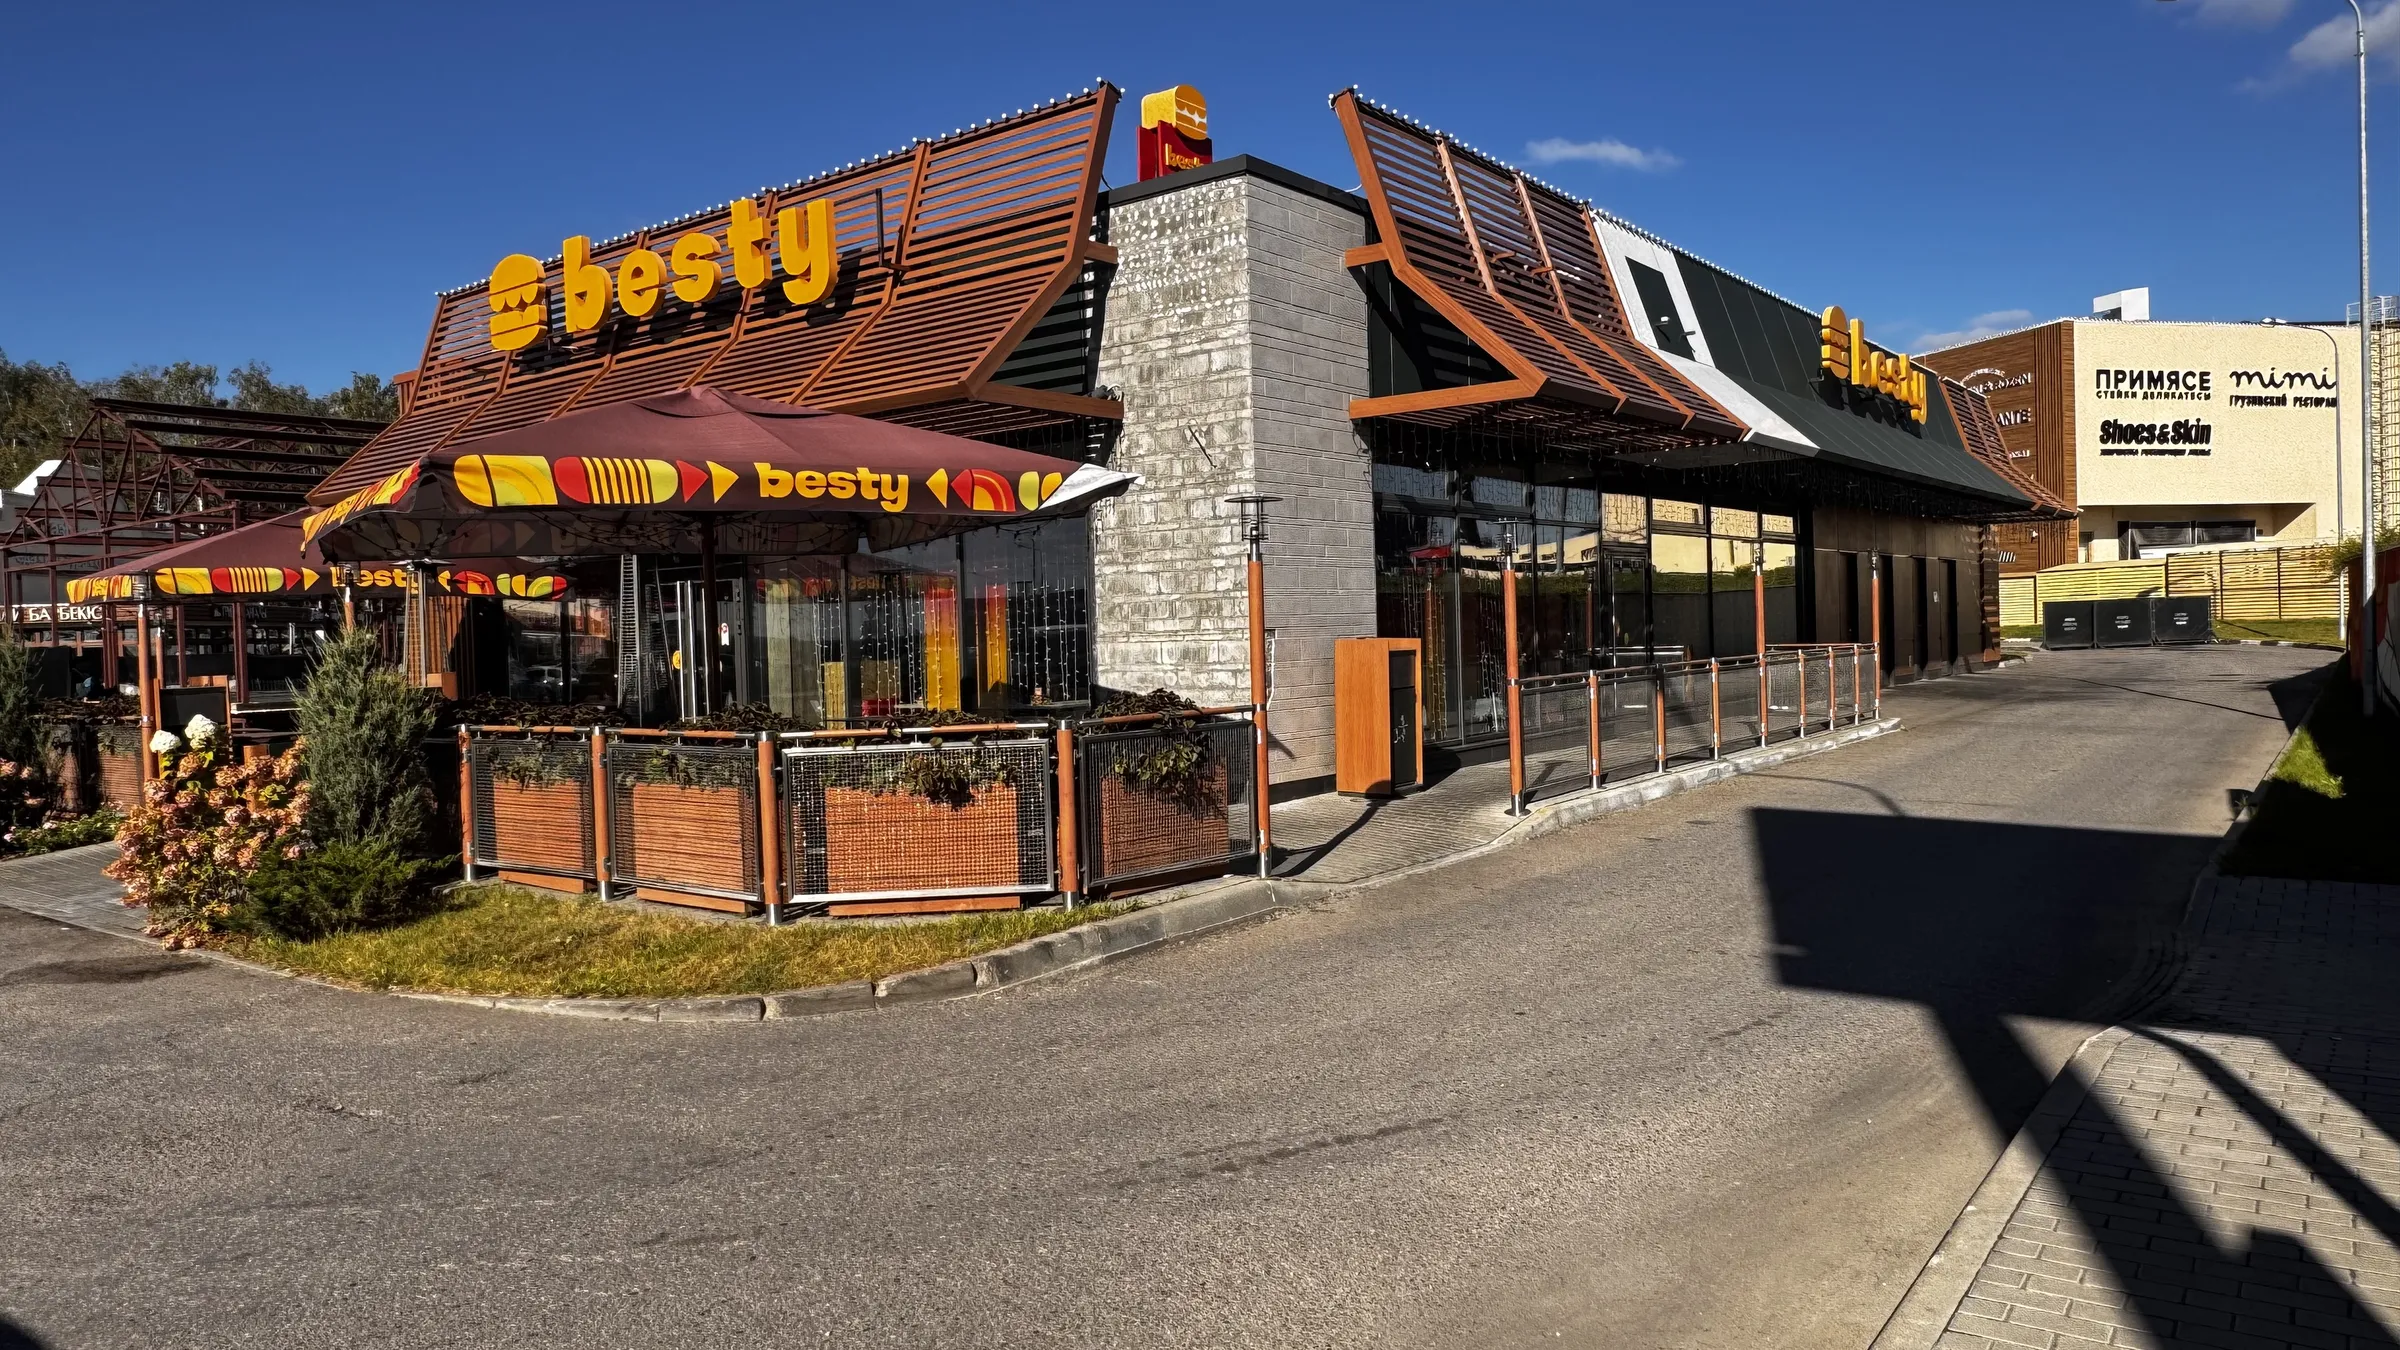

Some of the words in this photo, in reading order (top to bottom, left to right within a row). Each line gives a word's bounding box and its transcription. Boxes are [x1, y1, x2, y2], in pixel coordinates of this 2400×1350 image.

[1165, 143, 1204, 170] best
[563, 198, 838, 333] besty
[1850, 318, 1928, 425] besty
[2096, 369, 2211, 391] ПРИМЯСЕ
[2229, 367, 2337, 390] mimi
[753, 462, 909, 513] besty
[29, 606, 103, 621] БАБЕКЮ
